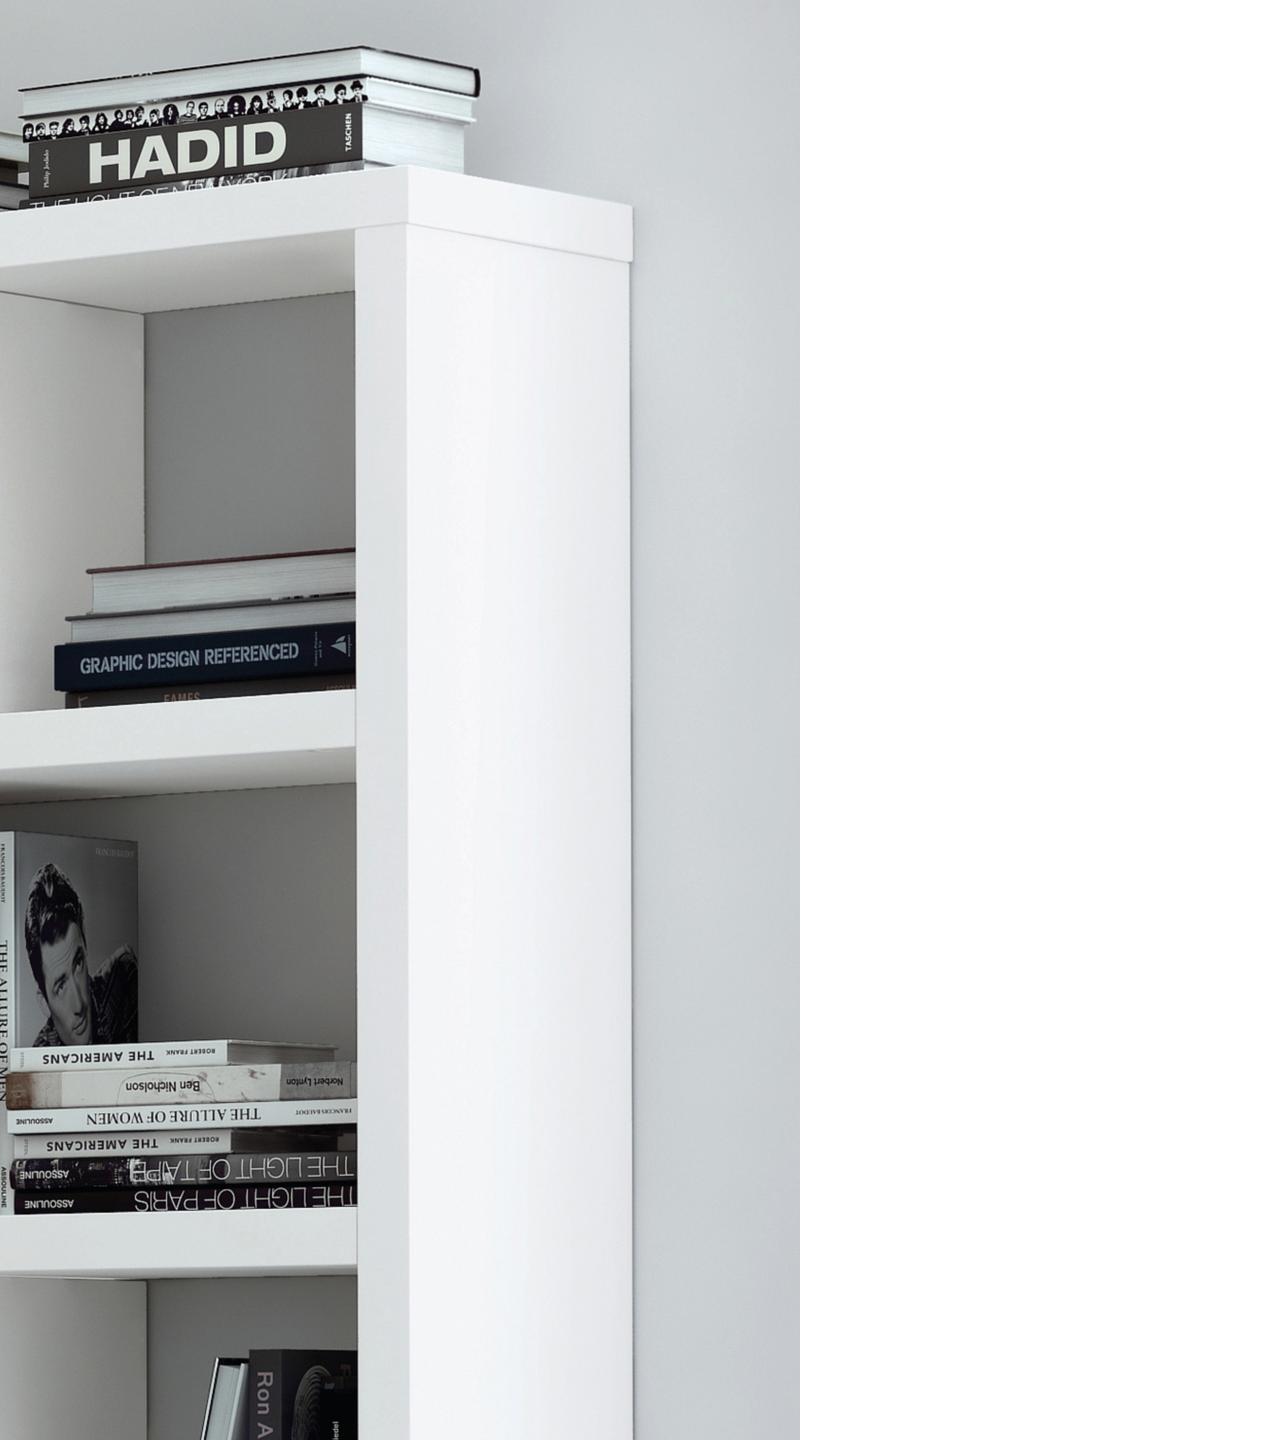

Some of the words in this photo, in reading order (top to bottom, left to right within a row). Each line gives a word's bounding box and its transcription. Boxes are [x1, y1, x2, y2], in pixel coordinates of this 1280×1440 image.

[345, 113, 353, 152] TASCHEN
[88, 120, 288, 184] HADID
[80, 654, 142, 673] GRAPHIC
[147, 649, 199, 669] DESIGN
[204, 642, 298, 664] REFERENCED
[42, 1051, 122, 1064] AMERICANS
[128, 1050, 154, 1061] THE
[125, 1081, 176, 1092] Nicholson
[179, 1081, 200, 1091] Ben
[87, 1112, 143, 1124] WOMEN
[147, 1111, 165, 1122] OF
[169, 1109, 226, 1122] ALLURE
[230, 1107, 261, 1120] THE
[257, 1372, 273, 1413] Ron
